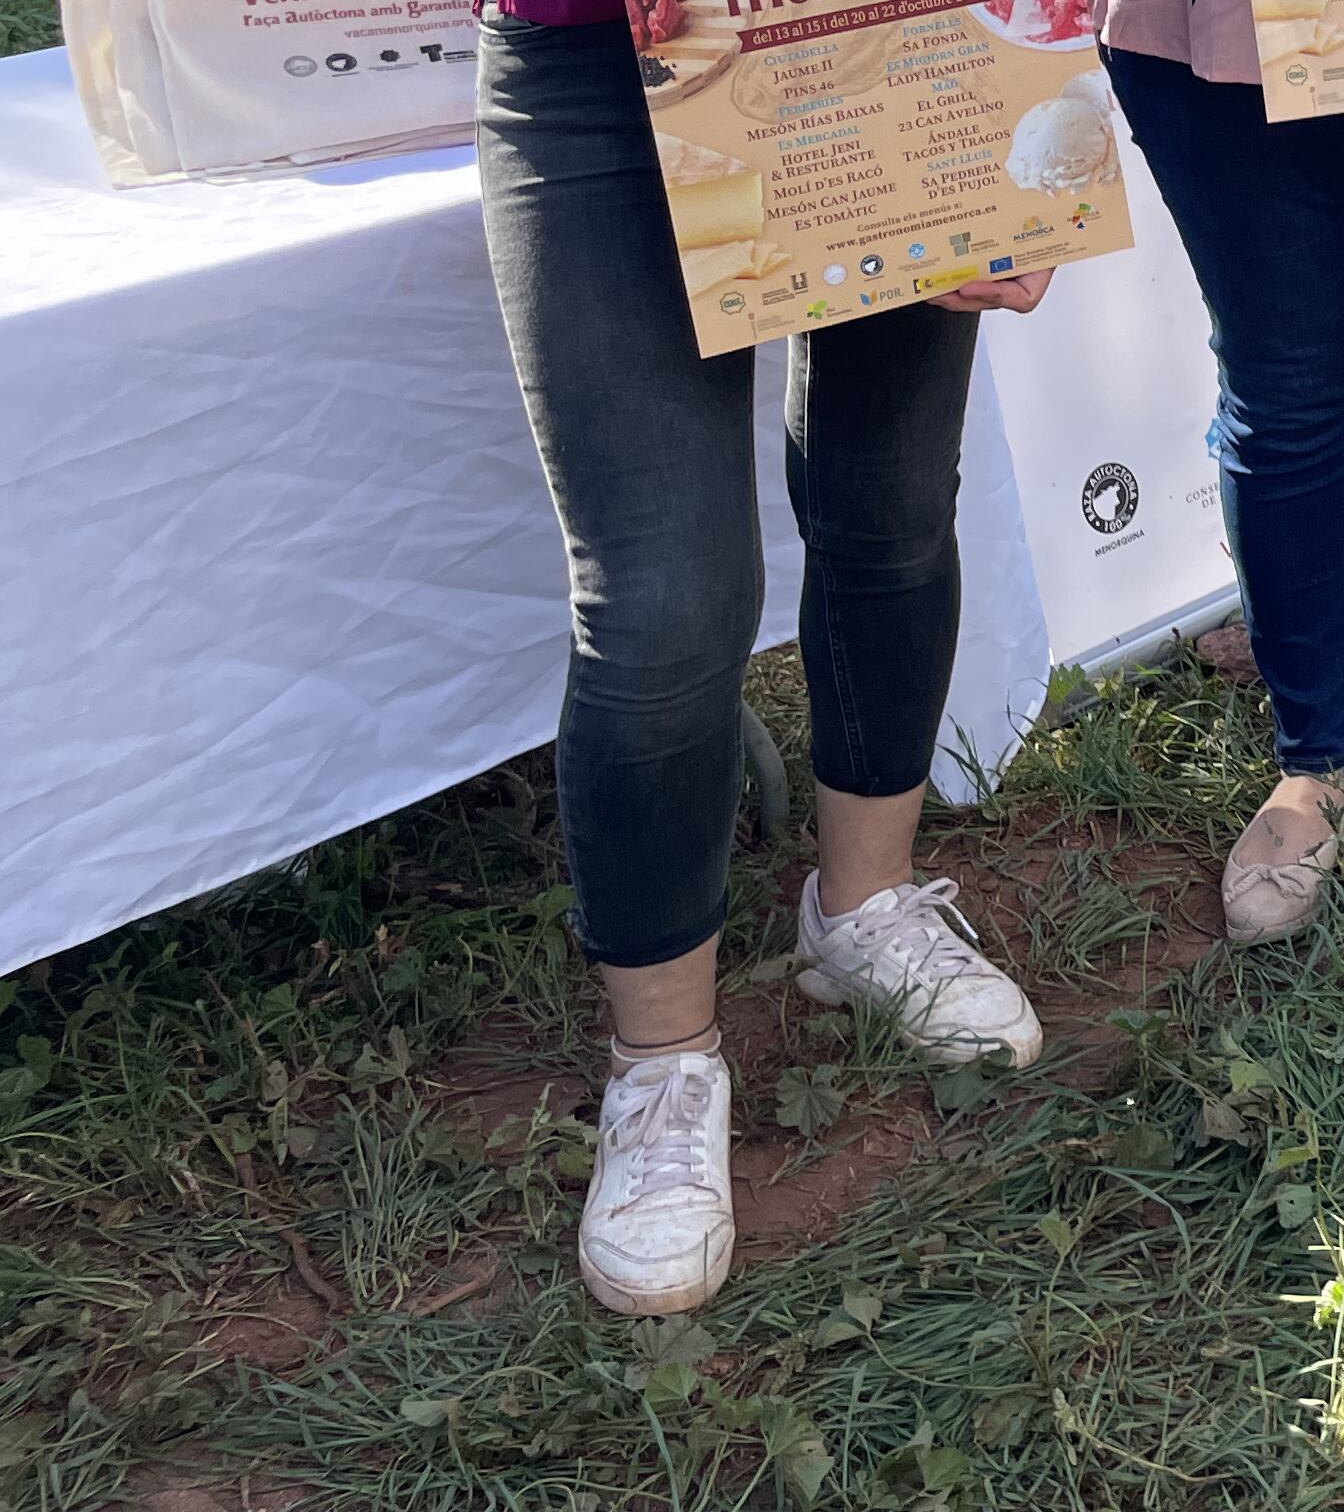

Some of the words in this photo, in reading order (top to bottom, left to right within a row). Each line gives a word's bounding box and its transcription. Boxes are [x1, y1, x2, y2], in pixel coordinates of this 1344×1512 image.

[243, 14, 280, 28] raça
[285, 3, 366, 24] autòctona
[371, 2, 402, 17] amb
[344, 18, 474, 39] vacamenorquina.org
[751, 29, 772, 45] del
[775, 25, 790, 40] 13
[790, 22, 804, 36] al
[805, 19, 821, 33] 15
[822, 18, 828, 30] i
[829, 13, 849, 28] del
[850, 10, 866, 24] 20
[867, 7, 879, 20] al
[881, 3, 896, 17] 22
[902, 39, 919, 52] SA
[922, 29, 967, 48] FONDA
[772, 62, 820, 83] JAUME
[821, 59, 833, 71] II
[886, 60, 900, 72] ES
[886, 70, 921, 87] LADY
[924, 54, 995, 79] HAMILTON
[783, 82, 816, 99] PINS
[818, 80, 835, 92] 46
[916, 98, 934, 112] EL
[936, 88, 976, 107] GRILL
[745, 119, 797, 142] MESÓN
[799, 111, 833, 130] RÍAS
[834, 100, 885, 122] BAIXAS
[898, 120, 913, 132] 23
[915, 112, 943, 128] CAN
[944, 98, 1004, 121] AVELINO
[777, 138, 792, 151] ES
[794, 122, 861, 147] MERCADAL
[902, 143, 946, 163] TACOS
[946, 141, 957, 152] Y
[958, 128, 1011, 149] TRAGOS
[926, 119, 980, 144] ÁNDALE
[770, 169, 783, 182] &
[785, 147, 876, 179] RESTURANTE
[780, 145, 828, 166] HOTEL
[829, 138, 861, 156] JENI
[926, 156, 958, 172] SANT
[772, 180, 811, 201] MOLÍ
[814, 173, 843, 190] D'ES
[845, 163, 884, 183] RACÓ
[920, 174, 939, 189] SA
[940, 159, 1001, 184] PEDRERA
[927, 182, 955, 199] D'ES
[958, 173, 1000, 194] PUJOL
[766, 198, 818, 221] MESÓN
[819, 192, 849, 208] CAN
[850, 180, 897, 203] JAUME
[793, 217, 812, 232] ES
[813, 200, 877, 227] TOMÀTIC
[825, 202, 997, 254] www.gastronomiamenorca.es
[1201, 495, 1217, 509] DE
[1104, 510, 1132, 532] 100%
[1094, 529, 1145, 557] MENORQUINA
